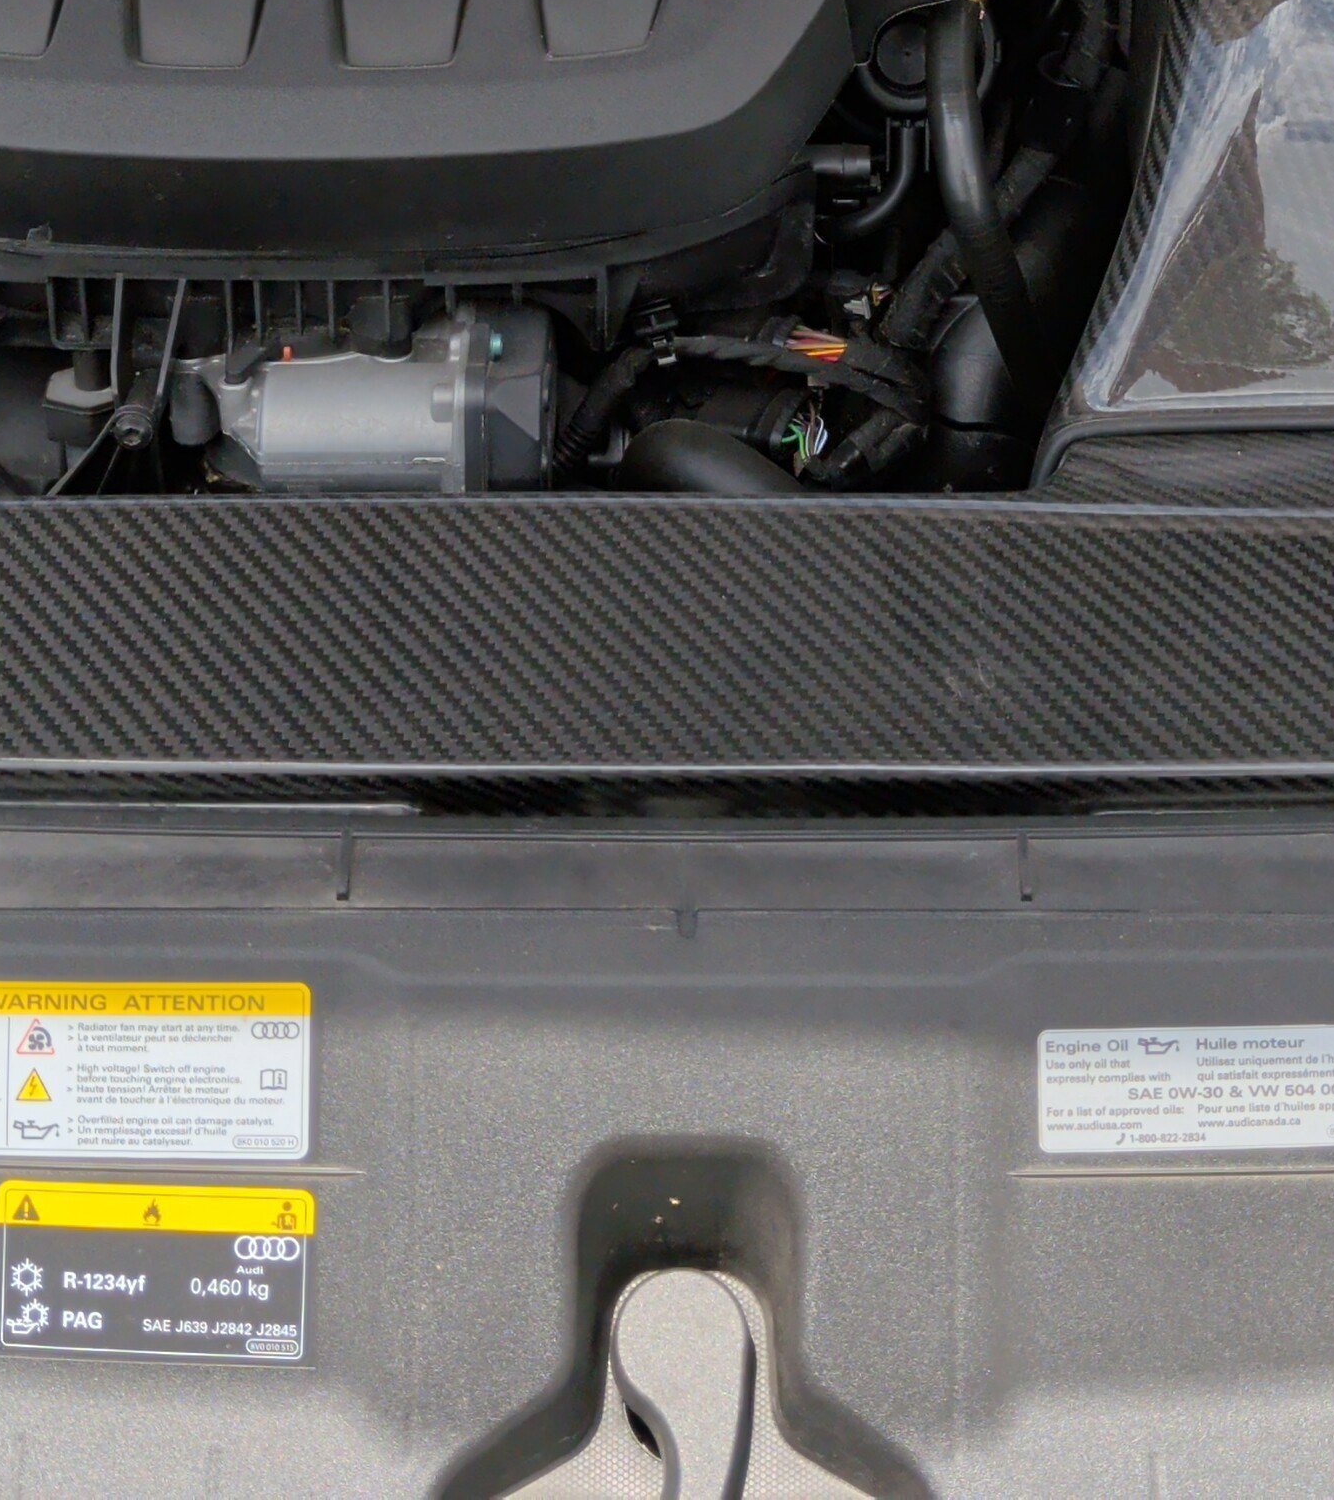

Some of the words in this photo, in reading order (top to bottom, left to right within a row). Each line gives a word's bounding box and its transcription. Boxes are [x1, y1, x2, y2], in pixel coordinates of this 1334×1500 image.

[123, 994, 265, 1012] ATTENTION
[78, 1023, 117, 1032] Radiator
[121, 1023, 135, 1032] fan
[138, 1024, 158, 1033] may
[161, 1024, 182, 1032] start
[185, 1024, 194, 1032] at
[197, 1025, 214, 1033] any
[217, 1024, 240, 1033] time.
[77, 1034, 89, 1043] Le
[91, 1034, 141, 1043] ventilateur
[145, 1035, 166, 1044] peut
[182, 1033, 232, 1043] déclencher
[1196, 1038, 1237, 1050] Huile
[1243, 1038, 1305, 1049] moteur
[77, 1043, 83, 1052] à
[86, 1044, 105, 1052] tout
[108, 1045, 150, 1053] moment.
[1045, 1041, 1101, 1056] Engine
[1107, 1039, 1129, 1052] Oil
[1046, 1060, 1065, 1069] Use
[1069, 1059, 1091, 1070] only
[1095, 1059, 1107, 1069] oil
[1110, 1058, 1131, 1068] that
[1197, 1057, 1236, 1067] Utilisez
[1239, 1055, 1302, 1067] uniquement
[1305, 1054, 1319, 1064] de
[77, 1065, 99, 1075] High
[102, 1065, 140, 1074] voltage!
[144, 1065, 175, 1074] Switch
[178, 1065, 191, 1074] off
[193, 1066, 225, 1076] engine
[1197, 1072, 1214, 1081] qui
[1217, 1070, 1259, 1080] satisfait
[77, 1075, 107, 1083] before
[110, 1075, 151, 1086] touching
[154, 1076, 187, 1086] engine
[189, 1075, 243, 1084] electronics.
[1046, 1073, 1096, 1085] expressly
[1098, 1073, 1146, 1084] complies
[1149, 1072, 1171, 1081] with
[77, 1085, 104, 1094] Haute
[107, 1086, 146, 1095] tension!
[148, 1085, 181, 1094] Arrêter
[184, 1086, 192, 1094] le
[195, 1086, 229, 1095] moteur
[1128, 1087, 1163, 1100] SAE
[1169, 1086, 1223, 1099] 0W-30
[1229, 1085, 1243, 1097] &
[1248, 1085, 1279, 1097] VW
[1285, 1084, 1316, 1096] 504
[77, 1096, 103, 1104] avant
[105, 1096, 117, 1104] de
[120, 1096, 156, 1105] toucher
[159, 1096, 164, 1105] à
[234, 1096, 246, 1105] du
[249, 1097, 285, 1105] moteur.
[1046, 1107, 1064, 1117] For
[1077, 1107, 1092, 1116] list
[1095, 1107, 1106, 1116] of
[1109, 1105, 1159, 1117] approved
[1162, 1105, 1184, 1115] oils:
[1198, 1103, 1223, 1113] Pour
[1226, 1104, 1246, 1113] une
[1249, 1103, 1271, 1112] liste
[78, 1116, 123, 1125] Overfilled
[126, 1117, 158, 1126] engine
[161, 1117, 173, 1125] oil
[176, 1117, 192, 1126] can
[195, 1117, 233, 1127] damage
[236, 1117, 274, 1128] catalyst.
[1047, 1120, 1142, 1131] www.audiusa.com
[1198, 1117, 1301, 1128] www.audicanada.ca
[78, 1127, 91, 1135] Un
[95, 1127, 152, 1137] remplissage
[155, 1127, 192, 1136] excessif
[77, 1138, 98, 1147] peut
[142, 1138, 193, 1147] catalyseur.
[1130, 1133, 1206, 1143] 1-800-822-2834
[235, 1265, 264, 1275] Audi
[63, 1271, 146, 1295] R-1234yf
[190, 1277, 241, 1297] 0,460
[248, 1278, 270, 1300] kg
[62, 1311, 103, 1330] PAG
[142, 1319, 171, 1333] SAE
[175, 1319, 208, 1335] J639
[212, 1320, 252, 1335] J2842
[256, 1322, 298, 1337] J2845
